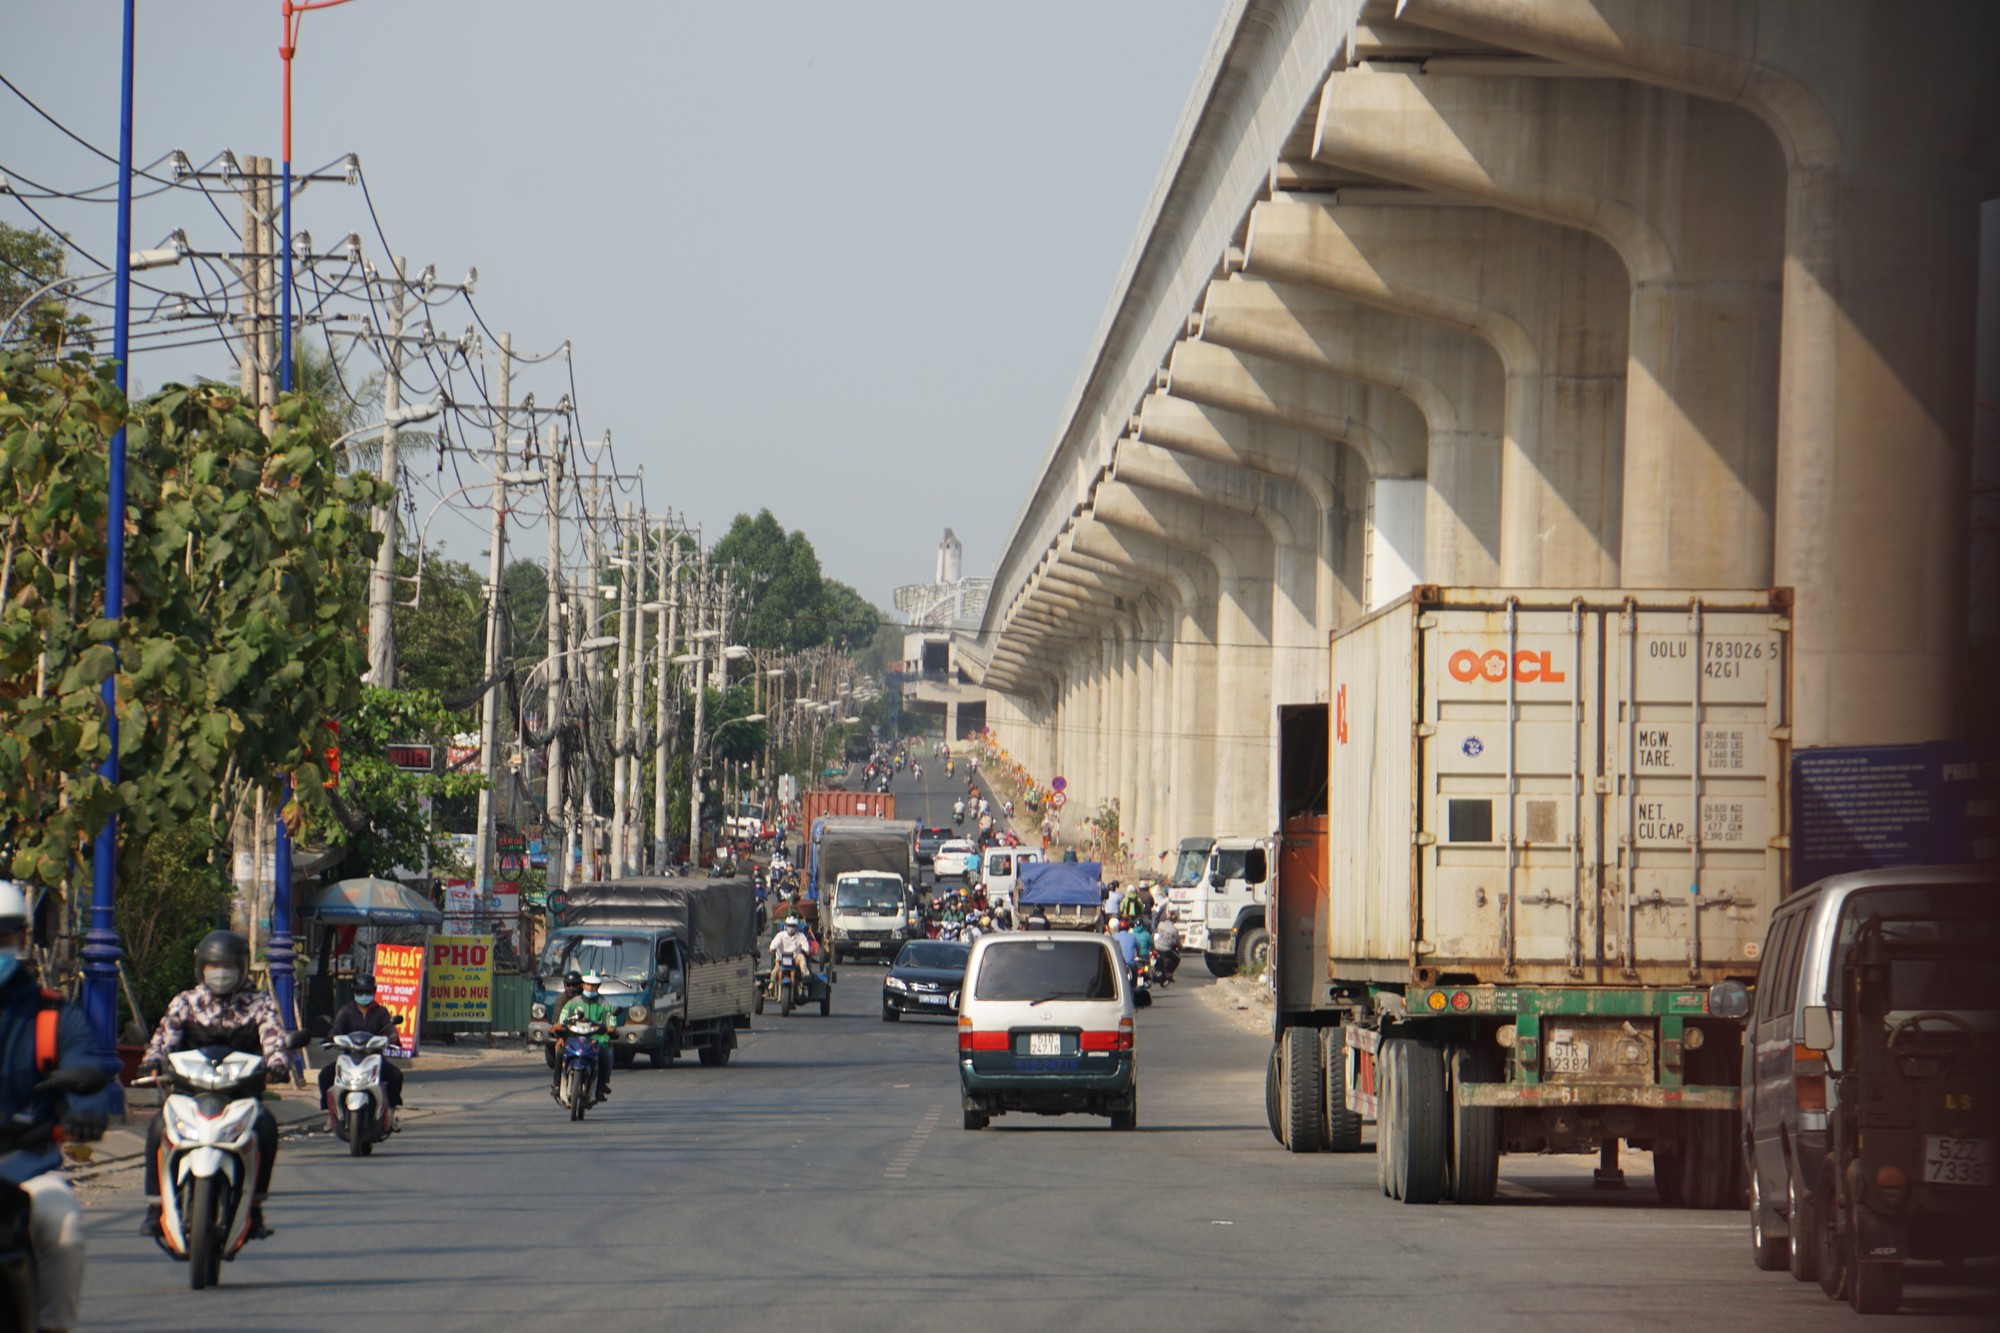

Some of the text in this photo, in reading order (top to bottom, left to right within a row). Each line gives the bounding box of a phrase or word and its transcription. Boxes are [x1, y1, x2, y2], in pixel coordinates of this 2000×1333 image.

[1705, 641, 1762, 659] 783026
[1769, 642, 1778, 660] 5
[1448, 649, 1565, 684] OOCL
[1704, 661, 1740, 678] 42G1
[401, 946, 422, 969] ĐẤT
[432, 937, 489, 966] PHỞ
[1869, 1247, 1898, 1255] JEEP
